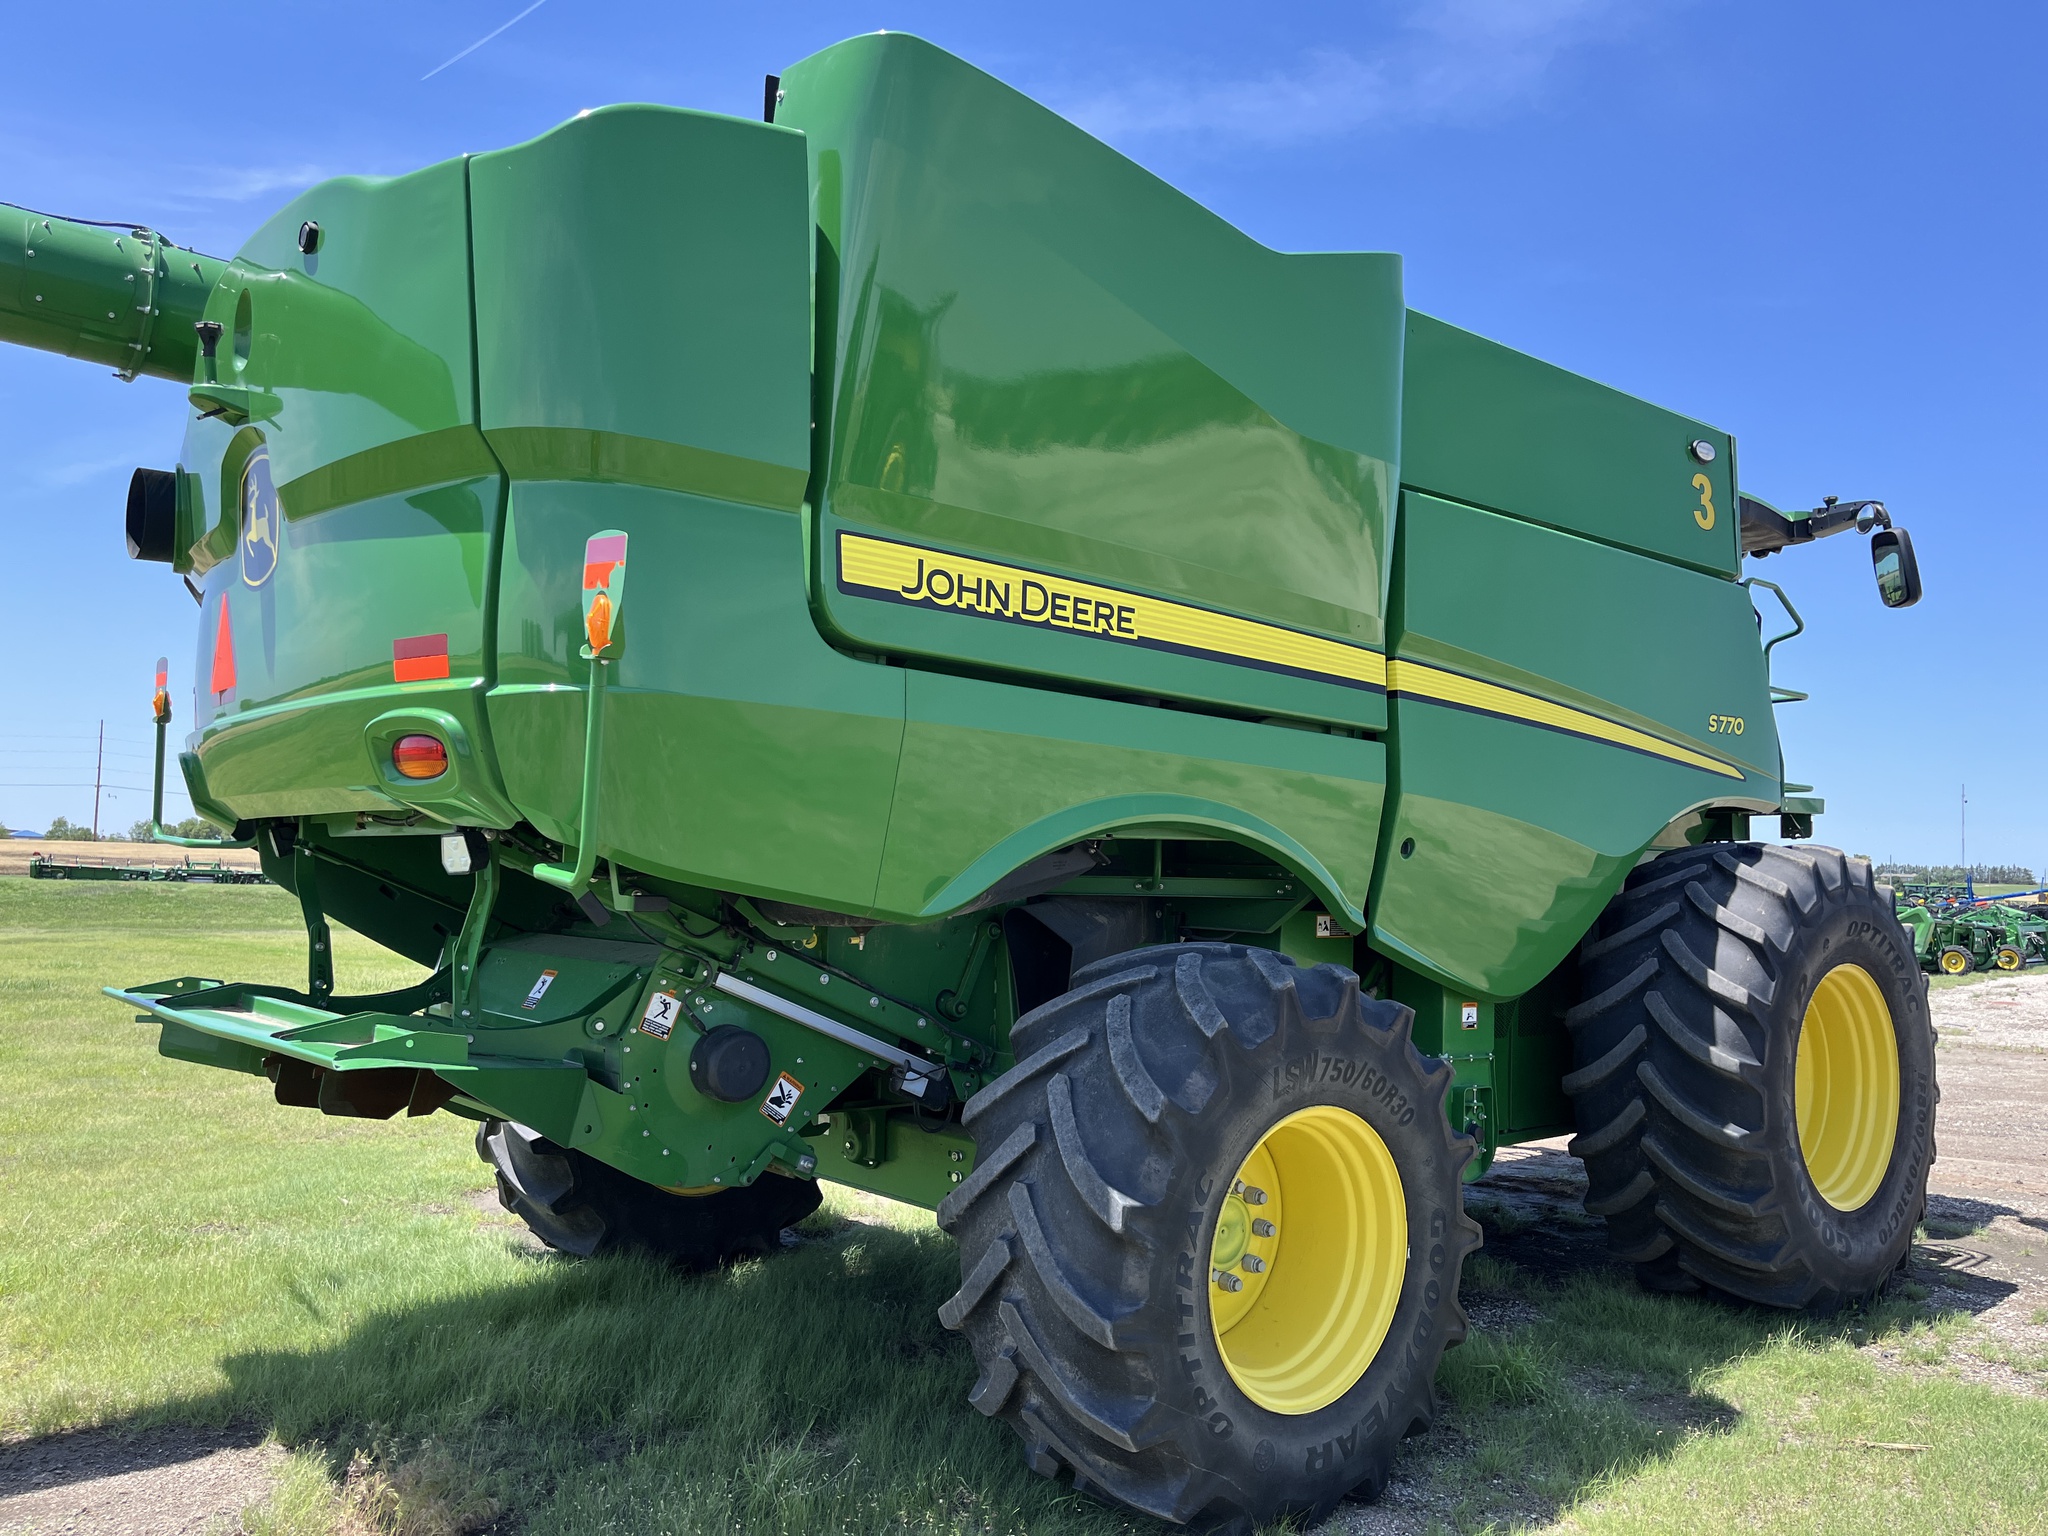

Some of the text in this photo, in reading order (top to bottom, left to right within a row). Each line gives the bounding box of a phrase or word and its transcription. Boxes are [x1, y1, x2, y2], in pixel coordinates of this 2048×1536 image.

[1691, 473, 1716, 531] 3
[901, 558, 1136, 634] JOHN DEERE
[1708, 714, 1744, 735] S770
[1846, 920, 1919, 1013] OPTITRAC
[1175, 1169, 1234, 1441] OPTITRAC
